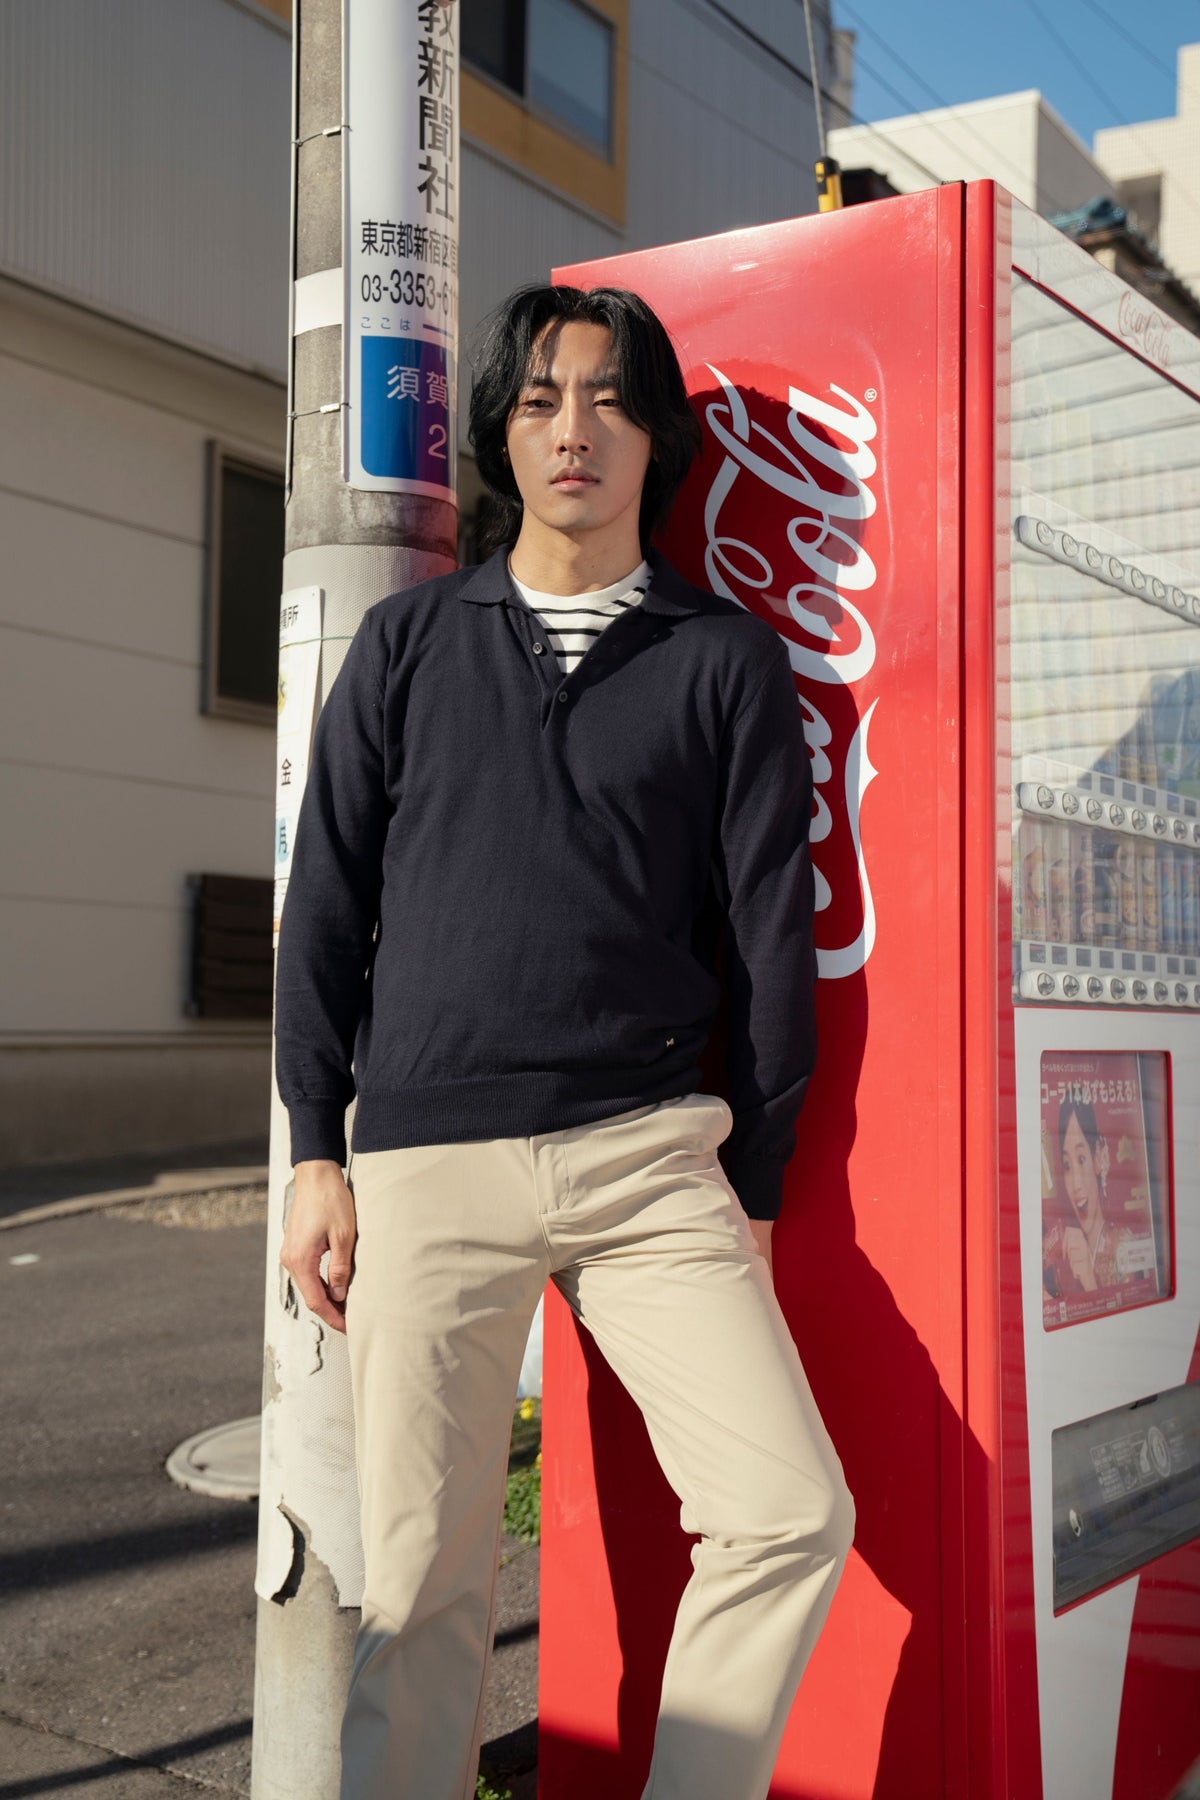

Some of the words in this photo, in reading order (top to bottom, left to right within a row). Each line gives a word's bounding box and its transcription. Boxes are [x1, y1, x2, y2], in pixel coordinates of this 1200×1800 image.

[361, 316, 411, 331] ここは
[428, 424, 447, 459] 2
